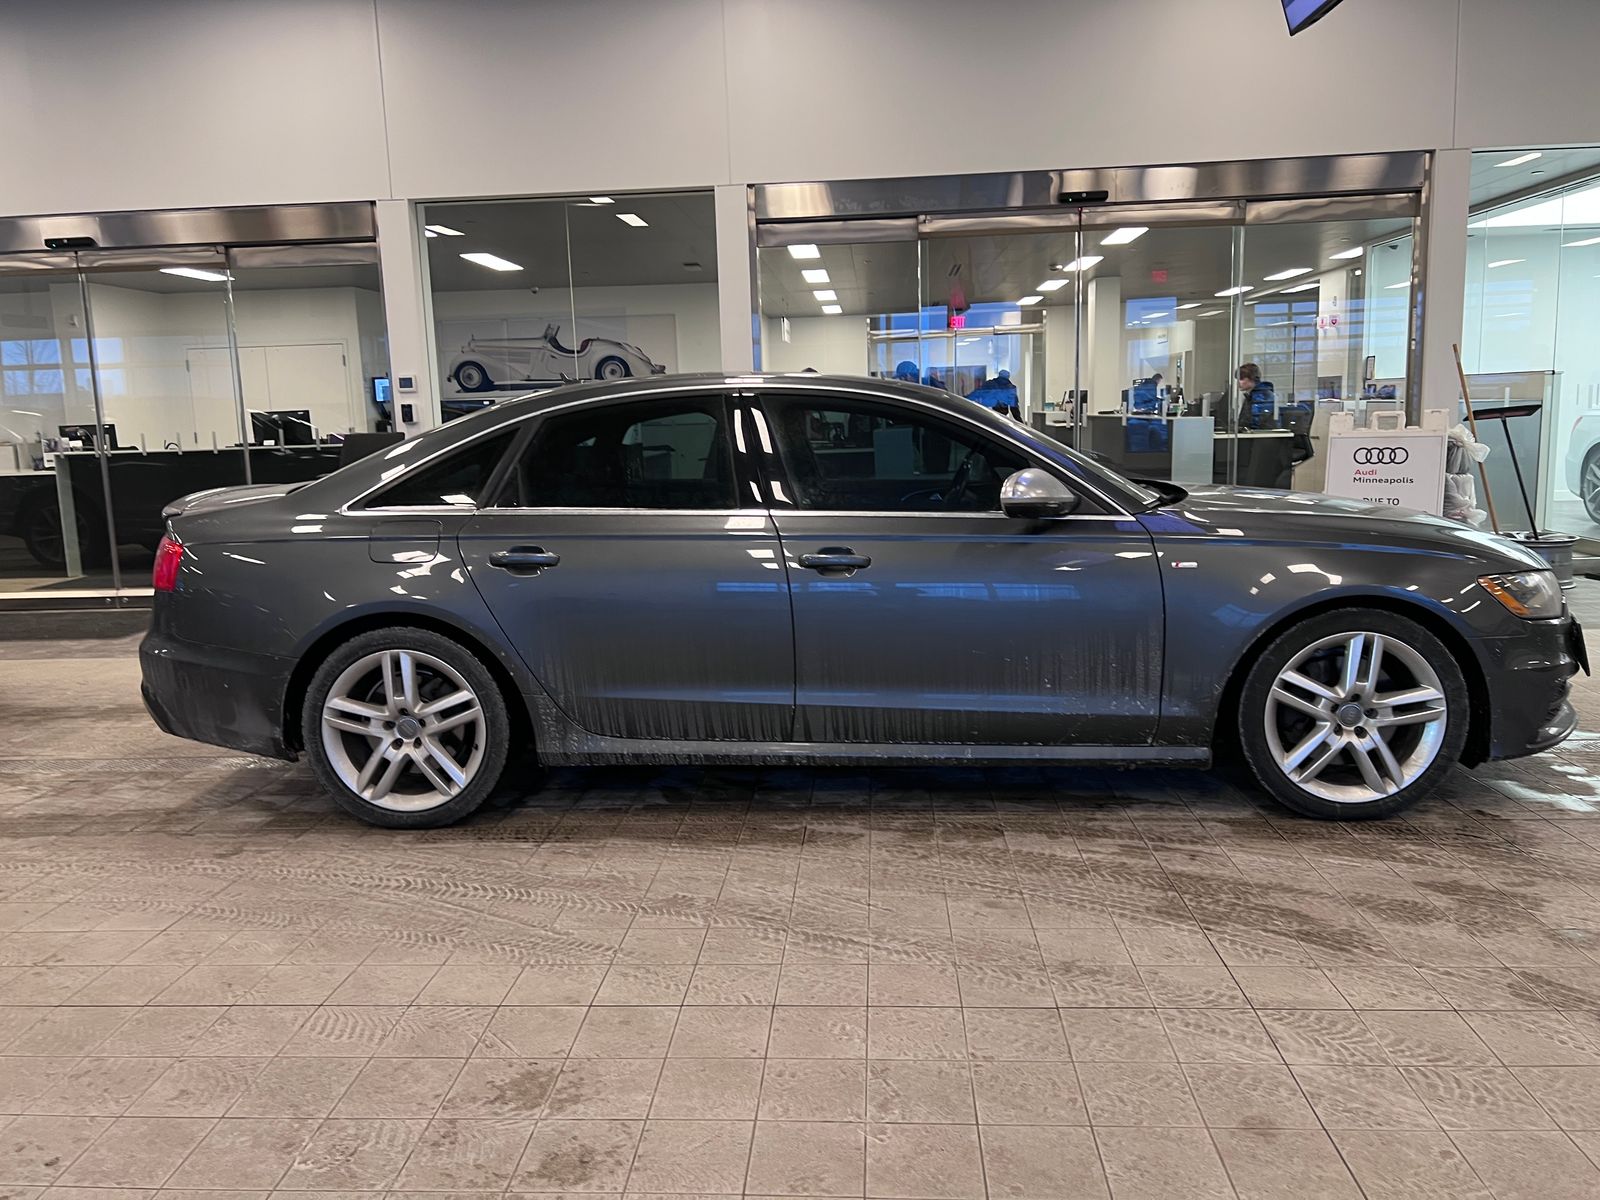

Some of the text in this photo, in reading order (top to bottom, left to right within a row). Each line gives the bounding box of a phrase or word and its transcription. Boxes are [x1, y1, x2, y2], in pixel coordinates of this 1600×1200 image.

[950, 316, 966, 328] EXIT
[1353, 477, 1414, 485] Minneapolis
[1386, 498, 1400, 506] TO
